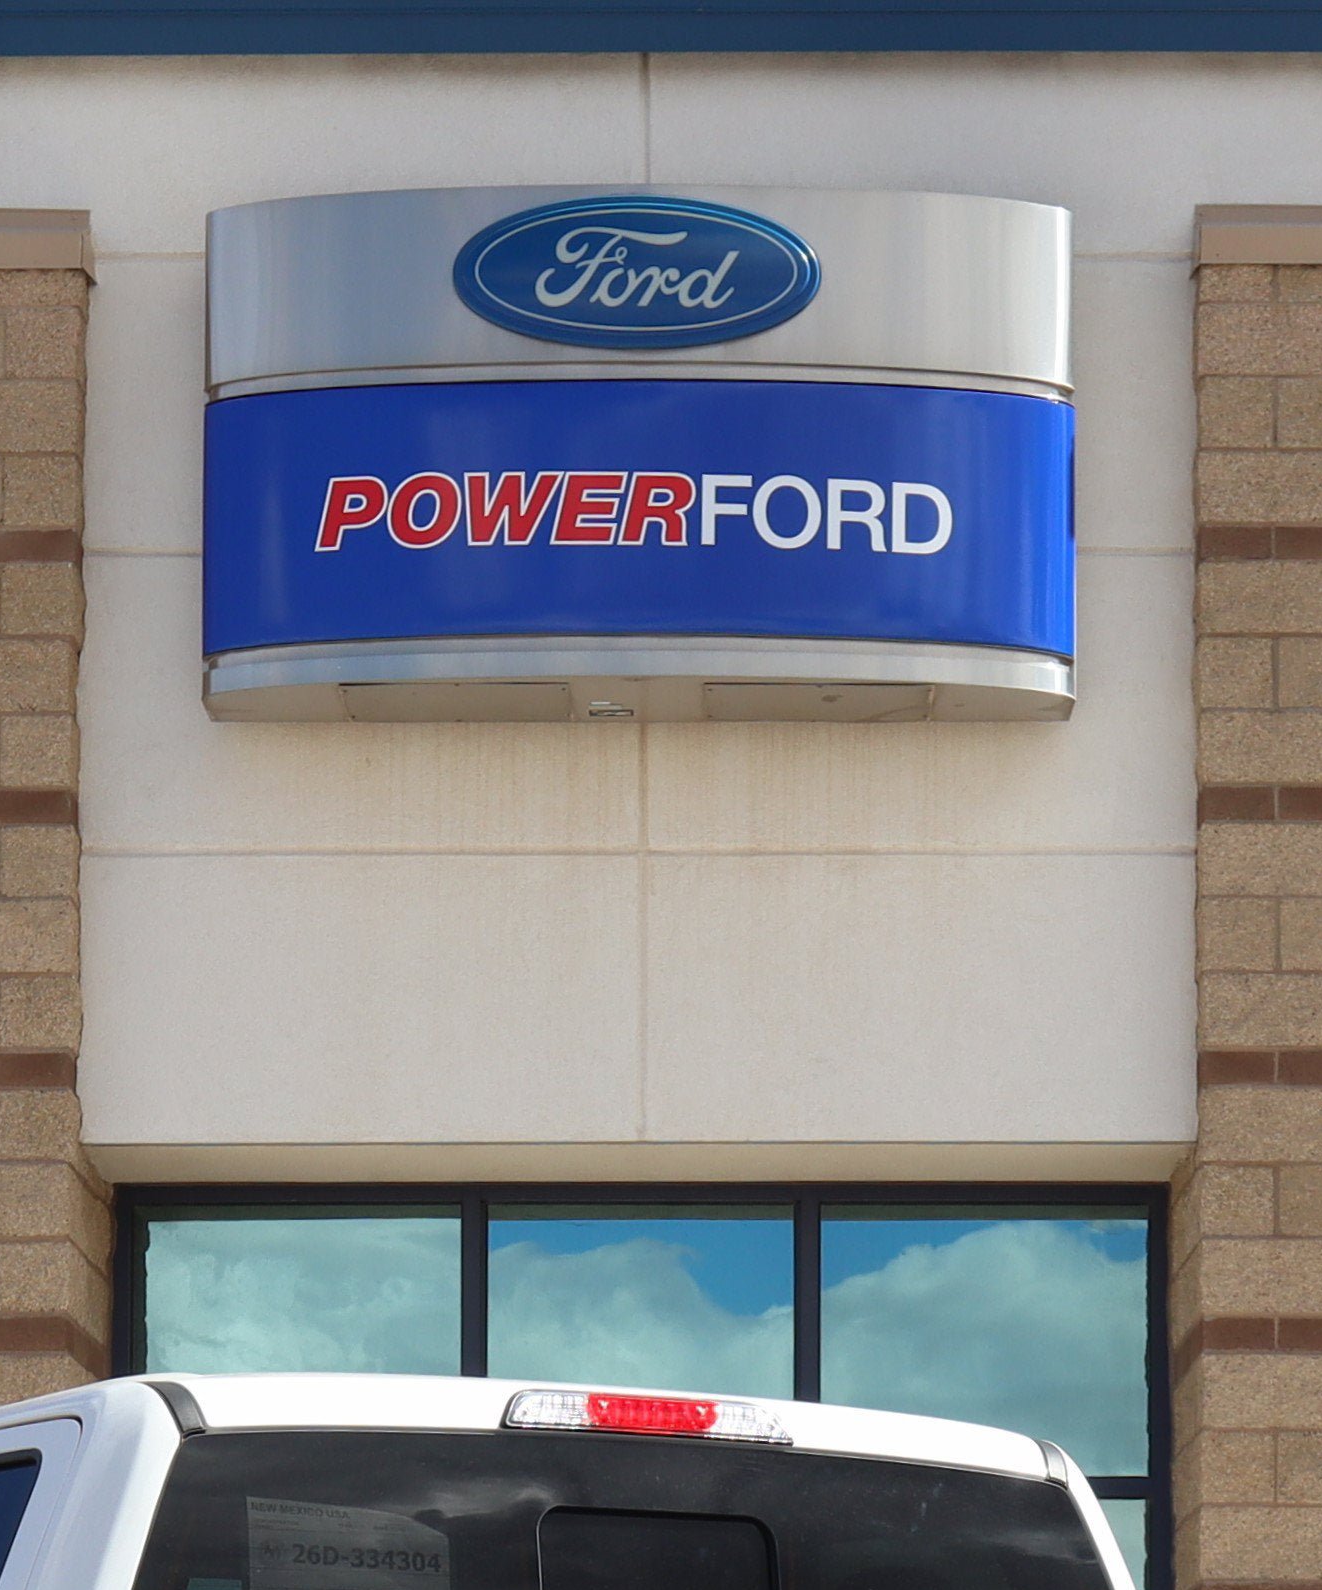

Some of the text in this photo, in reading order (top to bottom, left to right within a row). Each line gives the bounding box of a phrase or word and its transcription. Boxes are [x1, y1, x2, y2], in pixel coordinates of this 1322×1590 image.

[534, 226, 740, 311] Ford
[279, 1503, 324, 1517] MEXICO
[291, 1543, 442, 1573] 26D-334304
